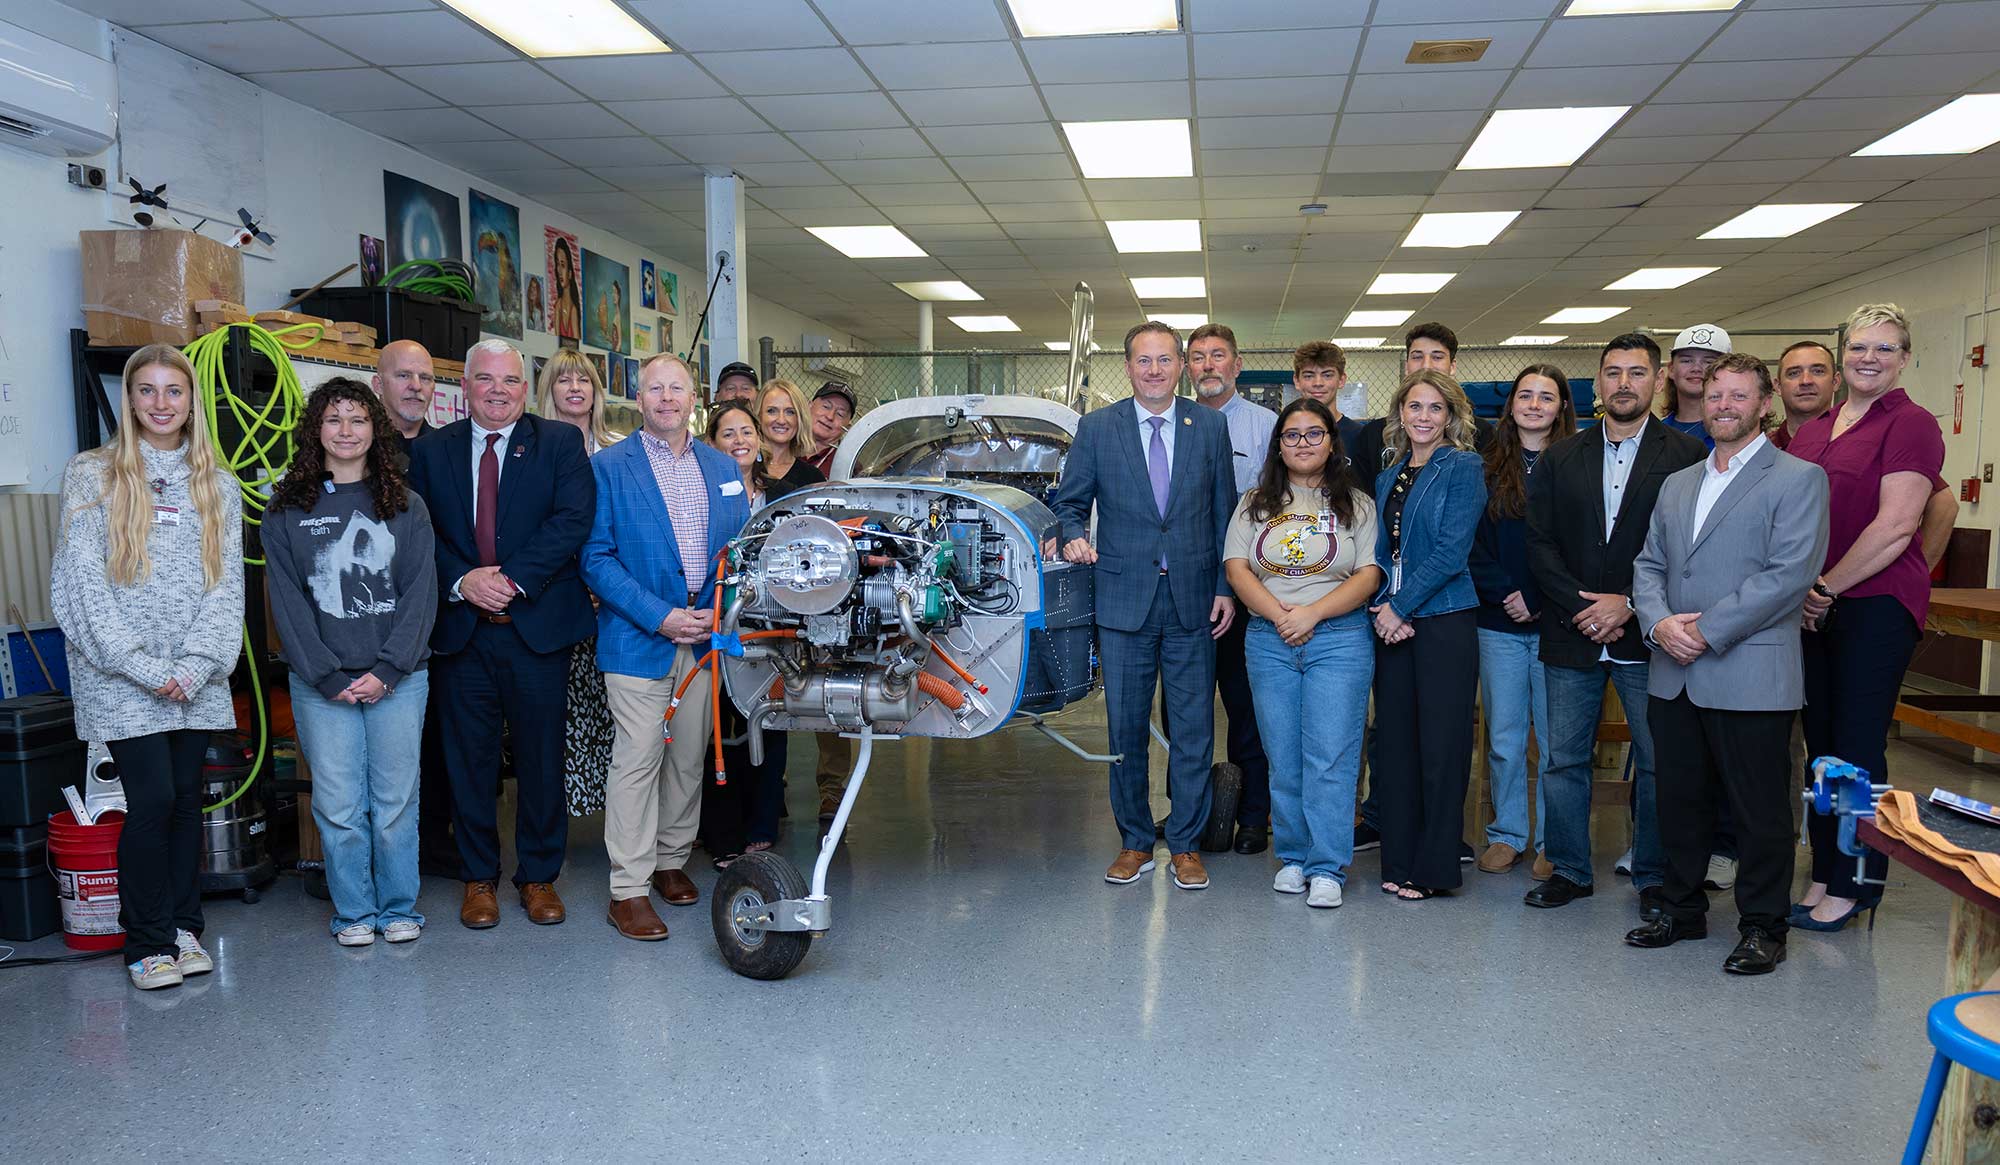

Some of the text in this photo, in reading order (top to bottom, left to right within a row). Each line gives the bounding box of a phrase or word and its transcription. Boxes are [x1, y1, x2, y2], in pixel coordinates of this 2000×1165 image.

[1288, 513, 1309, 521] BLUFF
[311, 526, 330, 535] faith
[1259, 557, 1278, 572] HOME
[1290, 558, 1330, 575] CHAMPIONS
[79, 875, 118, 885] Sunny
